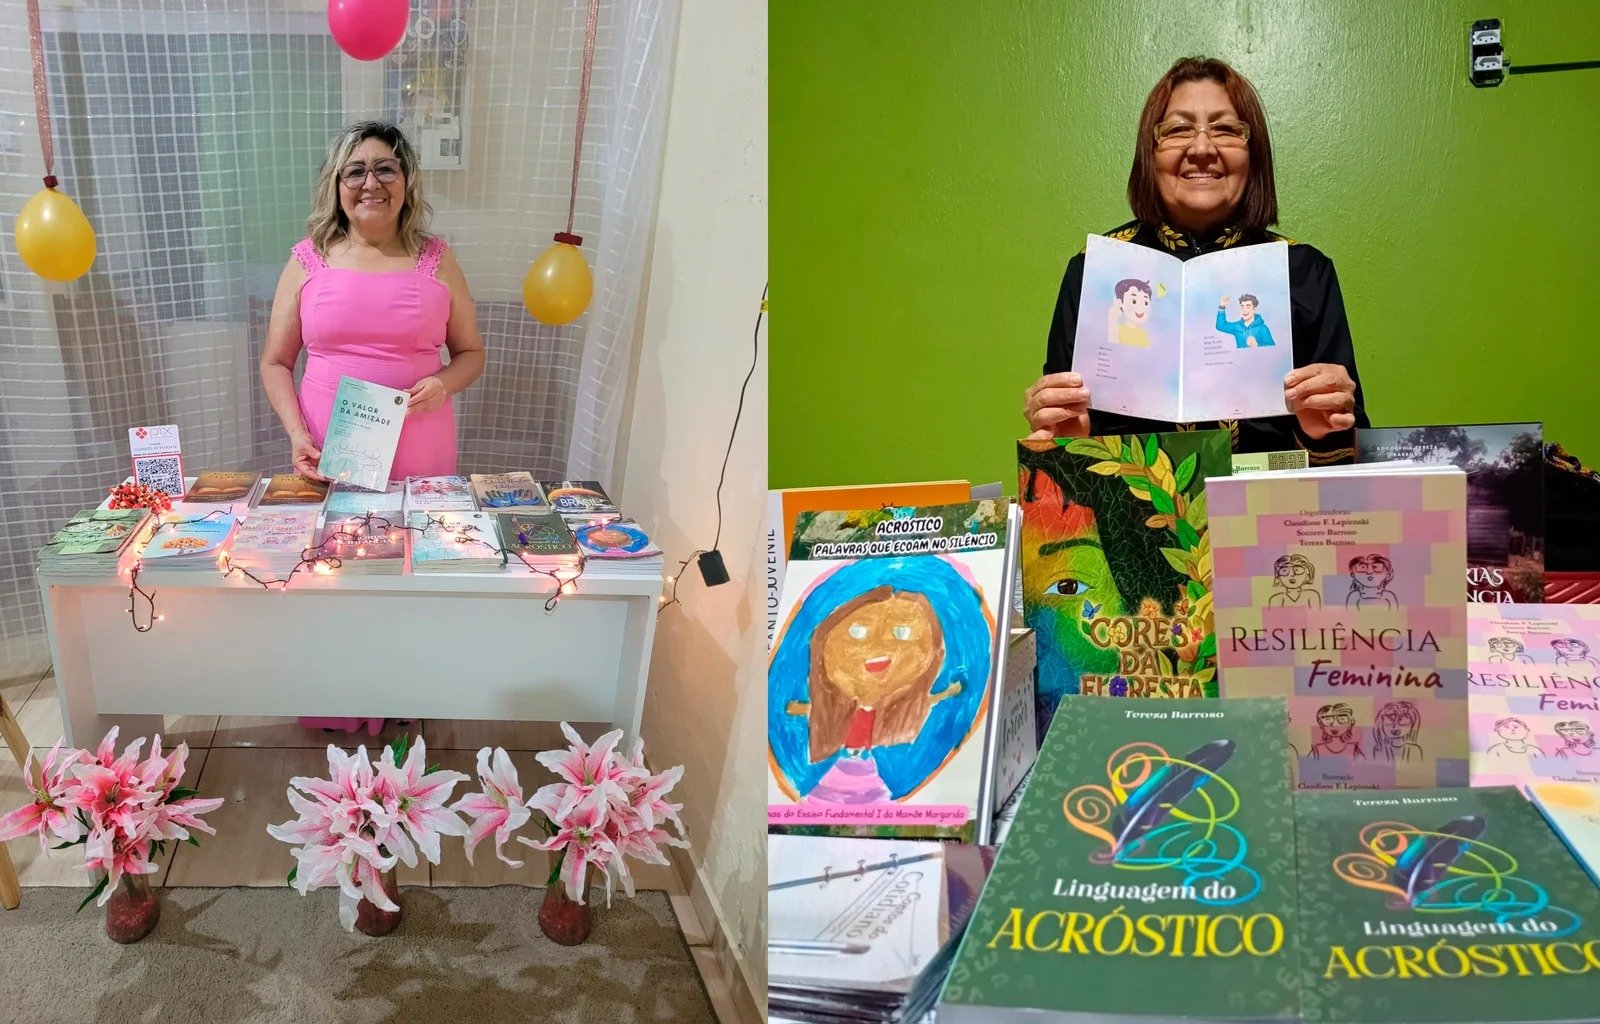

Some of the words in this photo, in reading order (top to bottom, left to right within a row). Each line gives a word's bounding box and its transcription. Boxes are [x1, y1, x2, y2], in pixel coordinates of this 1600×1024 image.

[340, 407, 351, 415] DA
[354, 411, 391, 426] AMIZADE
[352, 401, 379, 414] VALOR
[560, 498, 598, 508] BRASIL
[814, 544, 869, 556] PALAVRAS
[869, 542, 891, 554] QUE
[893, 540, 929, 552] ECOAM
[931, 538, 947, 550] NO
[949, 534, 997, 549] SILÊNCIO
[1089, 616, 1190, 649] CORES
[1229, 622, 1443, 652] RESILIÊNCIA
[1121, 650, 1159, 676] DA
[1307, 658, 1444, 689] Feminina
[1124, 710, 1168, 719] Tereza
[1171, 709, 1225, 719] Barroso
[1353, 798, 1399, 806] Tereza
[1402, 796, 1458, 805] Barroso
[797, 810, 823, 818] Ensino
[825, 809, 874, 819] Fundamental
[896, 809, 923, 818] Mamãe
[926, 809, 965, 822] Margarida
[1052, 878, 1198, 902] Linguagem
[1203, 880, 1237, 900] do
[986, 905, 1285, 957] ACRÓSTICO
[1363, 920, 1516, 939] Linguagem
[1521, 917, 1558, 933] do
